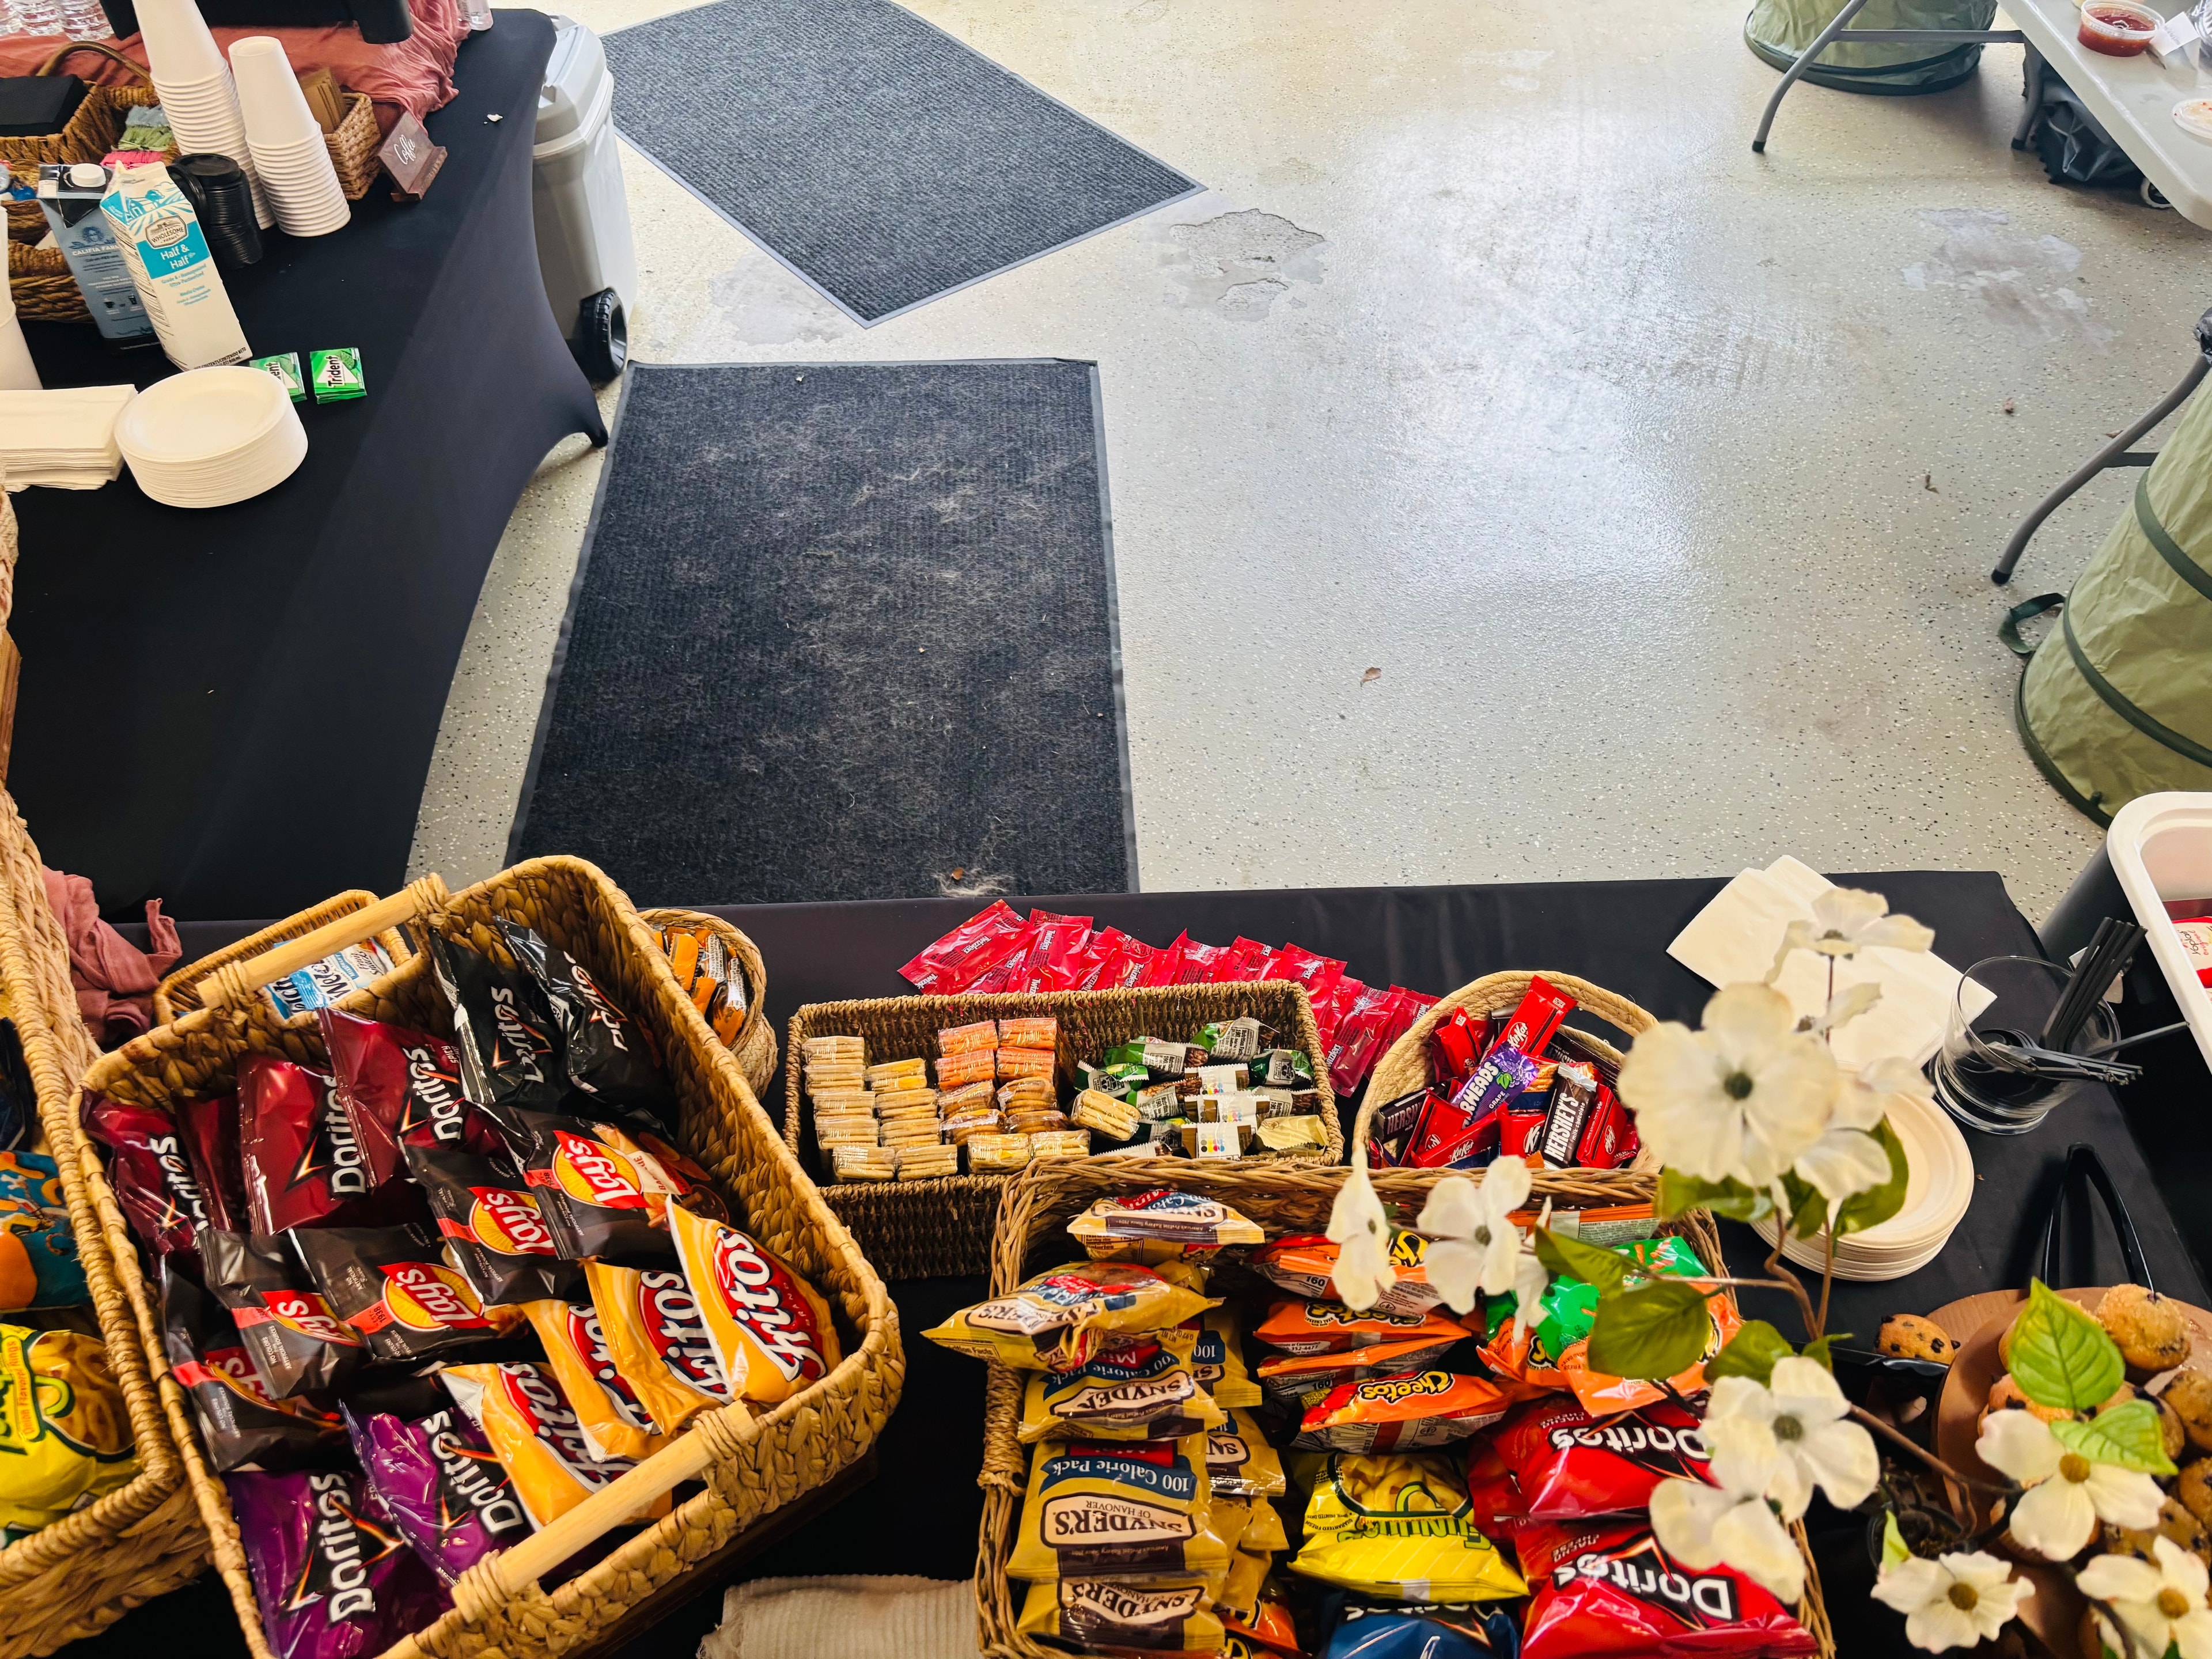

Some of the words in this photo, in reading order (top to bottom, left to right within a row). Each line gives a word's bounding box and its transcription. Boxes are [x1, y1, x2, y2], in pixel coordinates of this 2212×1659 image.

[394, 134, 416, 164] Coffee
[151, 226, 184, 244] WHOLESOME
[72, 247, 101, 256] CALIFIA
[161, 247, 180, 260] Half
[180, 244, 190, 253] &
[170, 256, 191, 270] Half
[328, 355, 343, 387] Trident
[961, 935, 993, 955] Twizzlers
[1039, 929, 1056, 952] Twizzlers
[2179, 930, 2201, 956] Yoplait
[310, 960, 352, 1002] Welc
[1029, 978, 1041, 995] Twizz
[1125, 963, 1145, 988] Twizzlers
[274, 977, 317, 1014] elch
[491, 986, 544, 1083] Doritos
[1508, 1021, 1528, 1048] KitKat
[441, 1046, 460, 1064] SPICY
[1325, 1043, 1344, 1071] wizzlers
[403, 1047, 464, 1141] Doritos
[1460, 1061, 1500, 1130] RHEADS
[1488, 1090, 1506, 1111] GRAPE
[1387, 1101, 1422, 1134] HERSH
[1543, 1092, 1580, 1162] HERSHEY'S
[1574, 1102, 1586, 1128] chocolate
[1448, 1139, 1475, 1164] KitKat
[149, 1136, 209, 1232] oritos
[566, 1139, 639, 1203] Lay's
[483, 1192, 555, 1251] Lay's
[1306, 1275, 1325, 1287] 160
[395, 1268, 479, 1323] Lay's
[716, 1226, 828, 1382] Fritos
[373, 1305, 388, 1324] 1938
[6, 1340, 21, 1368] Rings
[268, 1353, 278, 1365] NO
[972, 1347, 993, 1356] Facts
[1192, 1344, 1217, 1359] 100
[1092, 1363, 1151, 1379] Calorie
[1079, 1378, 1181, 1410] SNYDER
[1312, 1378, 1331, 1391] 160
[1361, 1371, 1452, 1402] Cheetos
[1551, 1426, 1713, 1459] Doritos
[421, 1410, 524, 1533] Doritos
[1052, 1459, 1090, 1475] Pack
[1096, 1460, 1158, 1485] Calorie
[1162, 1473, 1190, 1492] 100
[1085, 1500, 1136, 1515] HANOVER
[1137, 1509, 1151, 1518] OF
[1055, 1510, 1182, 1536] SNYDER'S
[1305, 1520, 1321, 1531] FRESH
[1322, 1518, 1353, 1531] GUARANTEED
[309, 1472, 376, 1623] Doritos
[1555, 1554, 1733, 1620] Doritos
